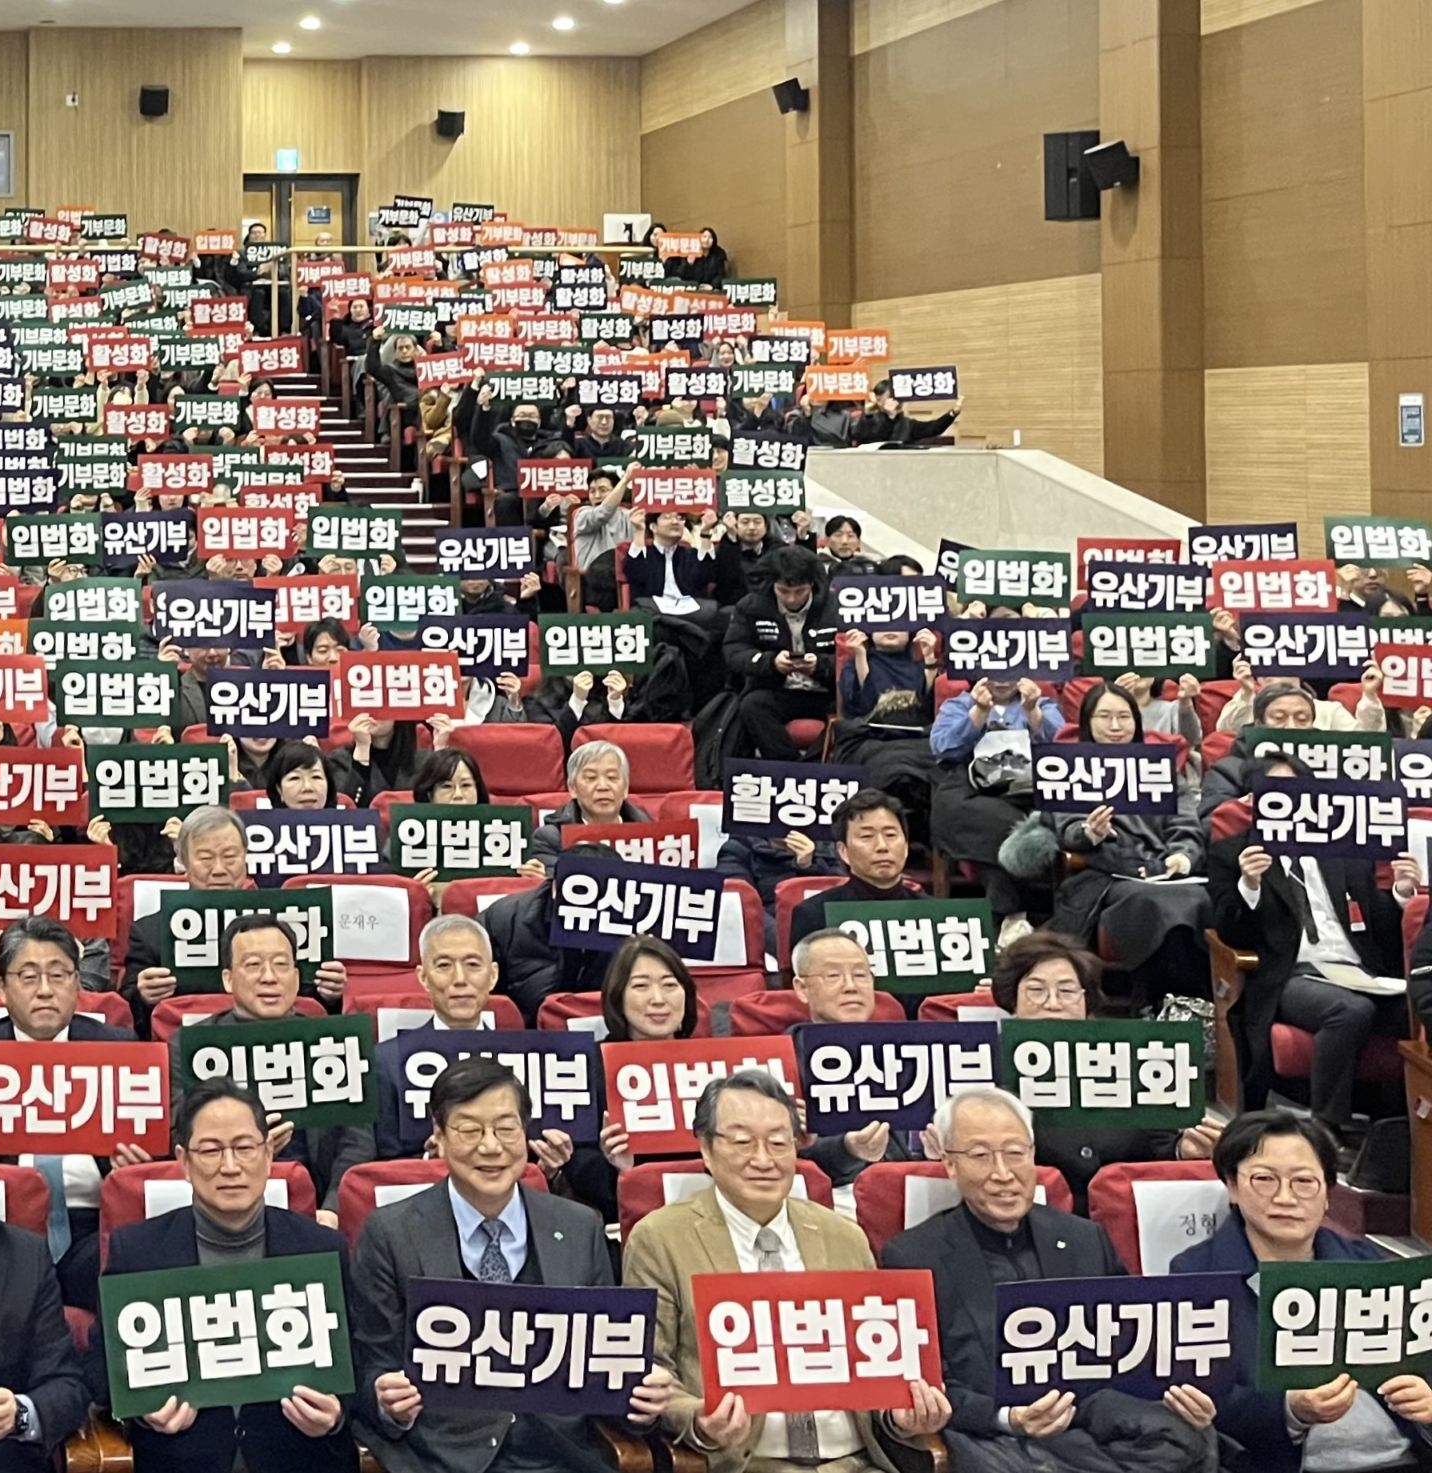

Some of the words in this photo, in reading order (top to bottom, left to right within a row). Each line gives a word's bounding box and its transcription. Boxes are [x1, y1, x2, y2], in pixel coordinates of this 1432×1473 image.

[194, 302, 245, 324] 활성화
[384, 309, 436, 330] 기부문화
[162, 344, 220, 365] 기부문화
[242, 348, 299, 369] 활성화
[465, 344, 523, 364] 기부문화
[752, 342, 809, 362] 활성화
[831, 336, 887, 355] 기부문화
[535, 352, 590, 373] 활성화
[490, 377, 556, 400] 기부문화
[580, 380, 639, 404] 활성화
[669, 372, 726, 395] 활성화
[734, 371, 794, 392] 기부문화
[808, 373, 868, 392] 기부문화
[893, 373, 955, 396] 활성화
[33, 394, 96, 418] 기부문화
[176, 402, 238, 424] 기부문화
[257, 406, 317, 430] 활성화
[107, 413, 166, 434] 활성화
[639, 434, 711, 459] 기부문화
[733, 439, 804, 469] 활성화
[59, 463, 126, 488] 기부문화
[142, 462, 210, 488] 활성화
[634, 479, 714, 505] 기부문화
[726, 478, 803, 507] 활성화
[13, 523, 98, 556] 입법화
[104, 521, 187, 554] 유산기부
[203, 518, 288, 549] 입법화
[312, 517, 398, 550] 입법화
[1331, 527, 1432, 560] 입법화
[439, 539, 531, 570] 유산기부
[964, 560, 1067, 597] 입법화
[1091, 572, 1205, 609] 유산기부
[1220, 571, 1331, 608] 입법화
[49, 588, 139, 620] 입법화
[170, 600, 272, 638] 유산기부
[366, 586, 458, 621] 입법화
[839, 587, 944, 628] 유산기부
[545, 626, 650, 666] 입법화
[949, 627, 1069, 669] 유산기부
[1090, 625, 1209, 667] 입법화
[1244, 625, 1366, 667] 유산기부
[63, 673, 174, 716] 입법화
[348, 664, 458, 706] 입법화
[210, 682, 327, 726] 유산기부
[96, 760, 224, 805] 입법화
[1035, 754, 1174, 802] 유산기부
[1256, 794, 1405, 846] 유산기부
[245, 822, 378, 874] 유산기부
[399, 820, 527, 869] 입법화
[557, 874, 717, 942] 유산기부
[1014, 1042, 1198, 1108] 입법화
[117, 1282, 340, 1389] 입법화
[414, 1306, 645, 1389] 유산기부
[710, 1296, 929, 1387] 입법화
[1002, 1300, 1231, 1388] 유산기부
